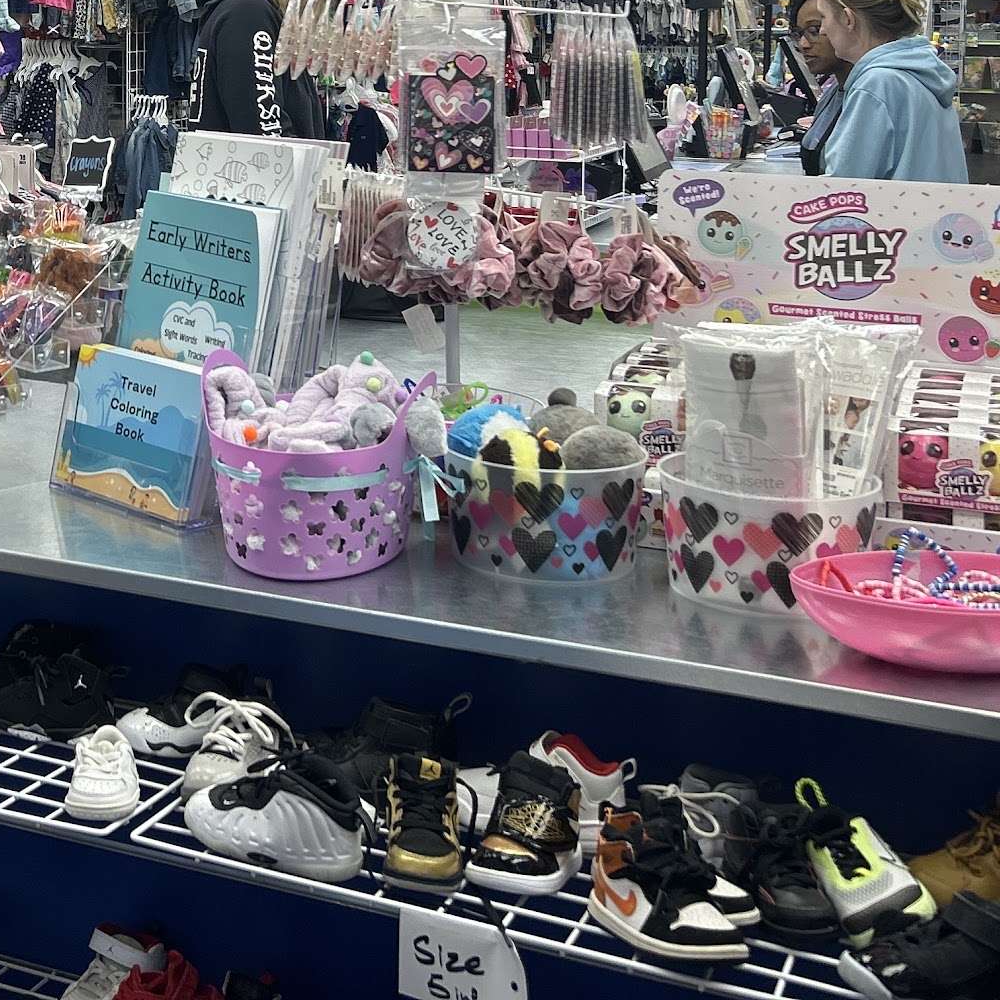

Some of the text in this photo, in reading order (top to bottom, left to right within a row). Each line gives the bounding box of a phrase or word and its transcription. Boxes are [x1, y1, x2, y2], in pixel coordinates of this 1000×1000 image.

[253, 30, 283, 138] QUIKSI
[69, 156, 106, 178] crayons
[678, 189, 721, 205] Scented!
[682, 183, 711, 194] We're
[793, 194, 863, 216] CAKE POPS
[436, 208, 468, 241] LOVE
[147, 220, 252, 264] Early Writers
[427, 227, 460, 256] LOVE
[787, 230, 904, 263] SMELLY
[798, 258, 893, 289] BALLZ
[141, 263, 246, 307] Activity Book
[173, 314, 196, 328] CVC and
[771, 304, 918, 325] Gourmet Scented Stress Balls
[164, 328, 198, 345] Sight Words
[204, 334, 226, 349] Writing
[121, 375, 158, 398] Travel
[110, 397, 160, 426] Coloring
[115, 422, 145, 443] Book
[642, 433, 686, 445] SMELLY
[700, 465, 785, 490] Marquisette
[940, 475, 987, 486] SMELLY
[944, 486, 984, 497] BALLZ
[413, 934, 485, 976] Size
